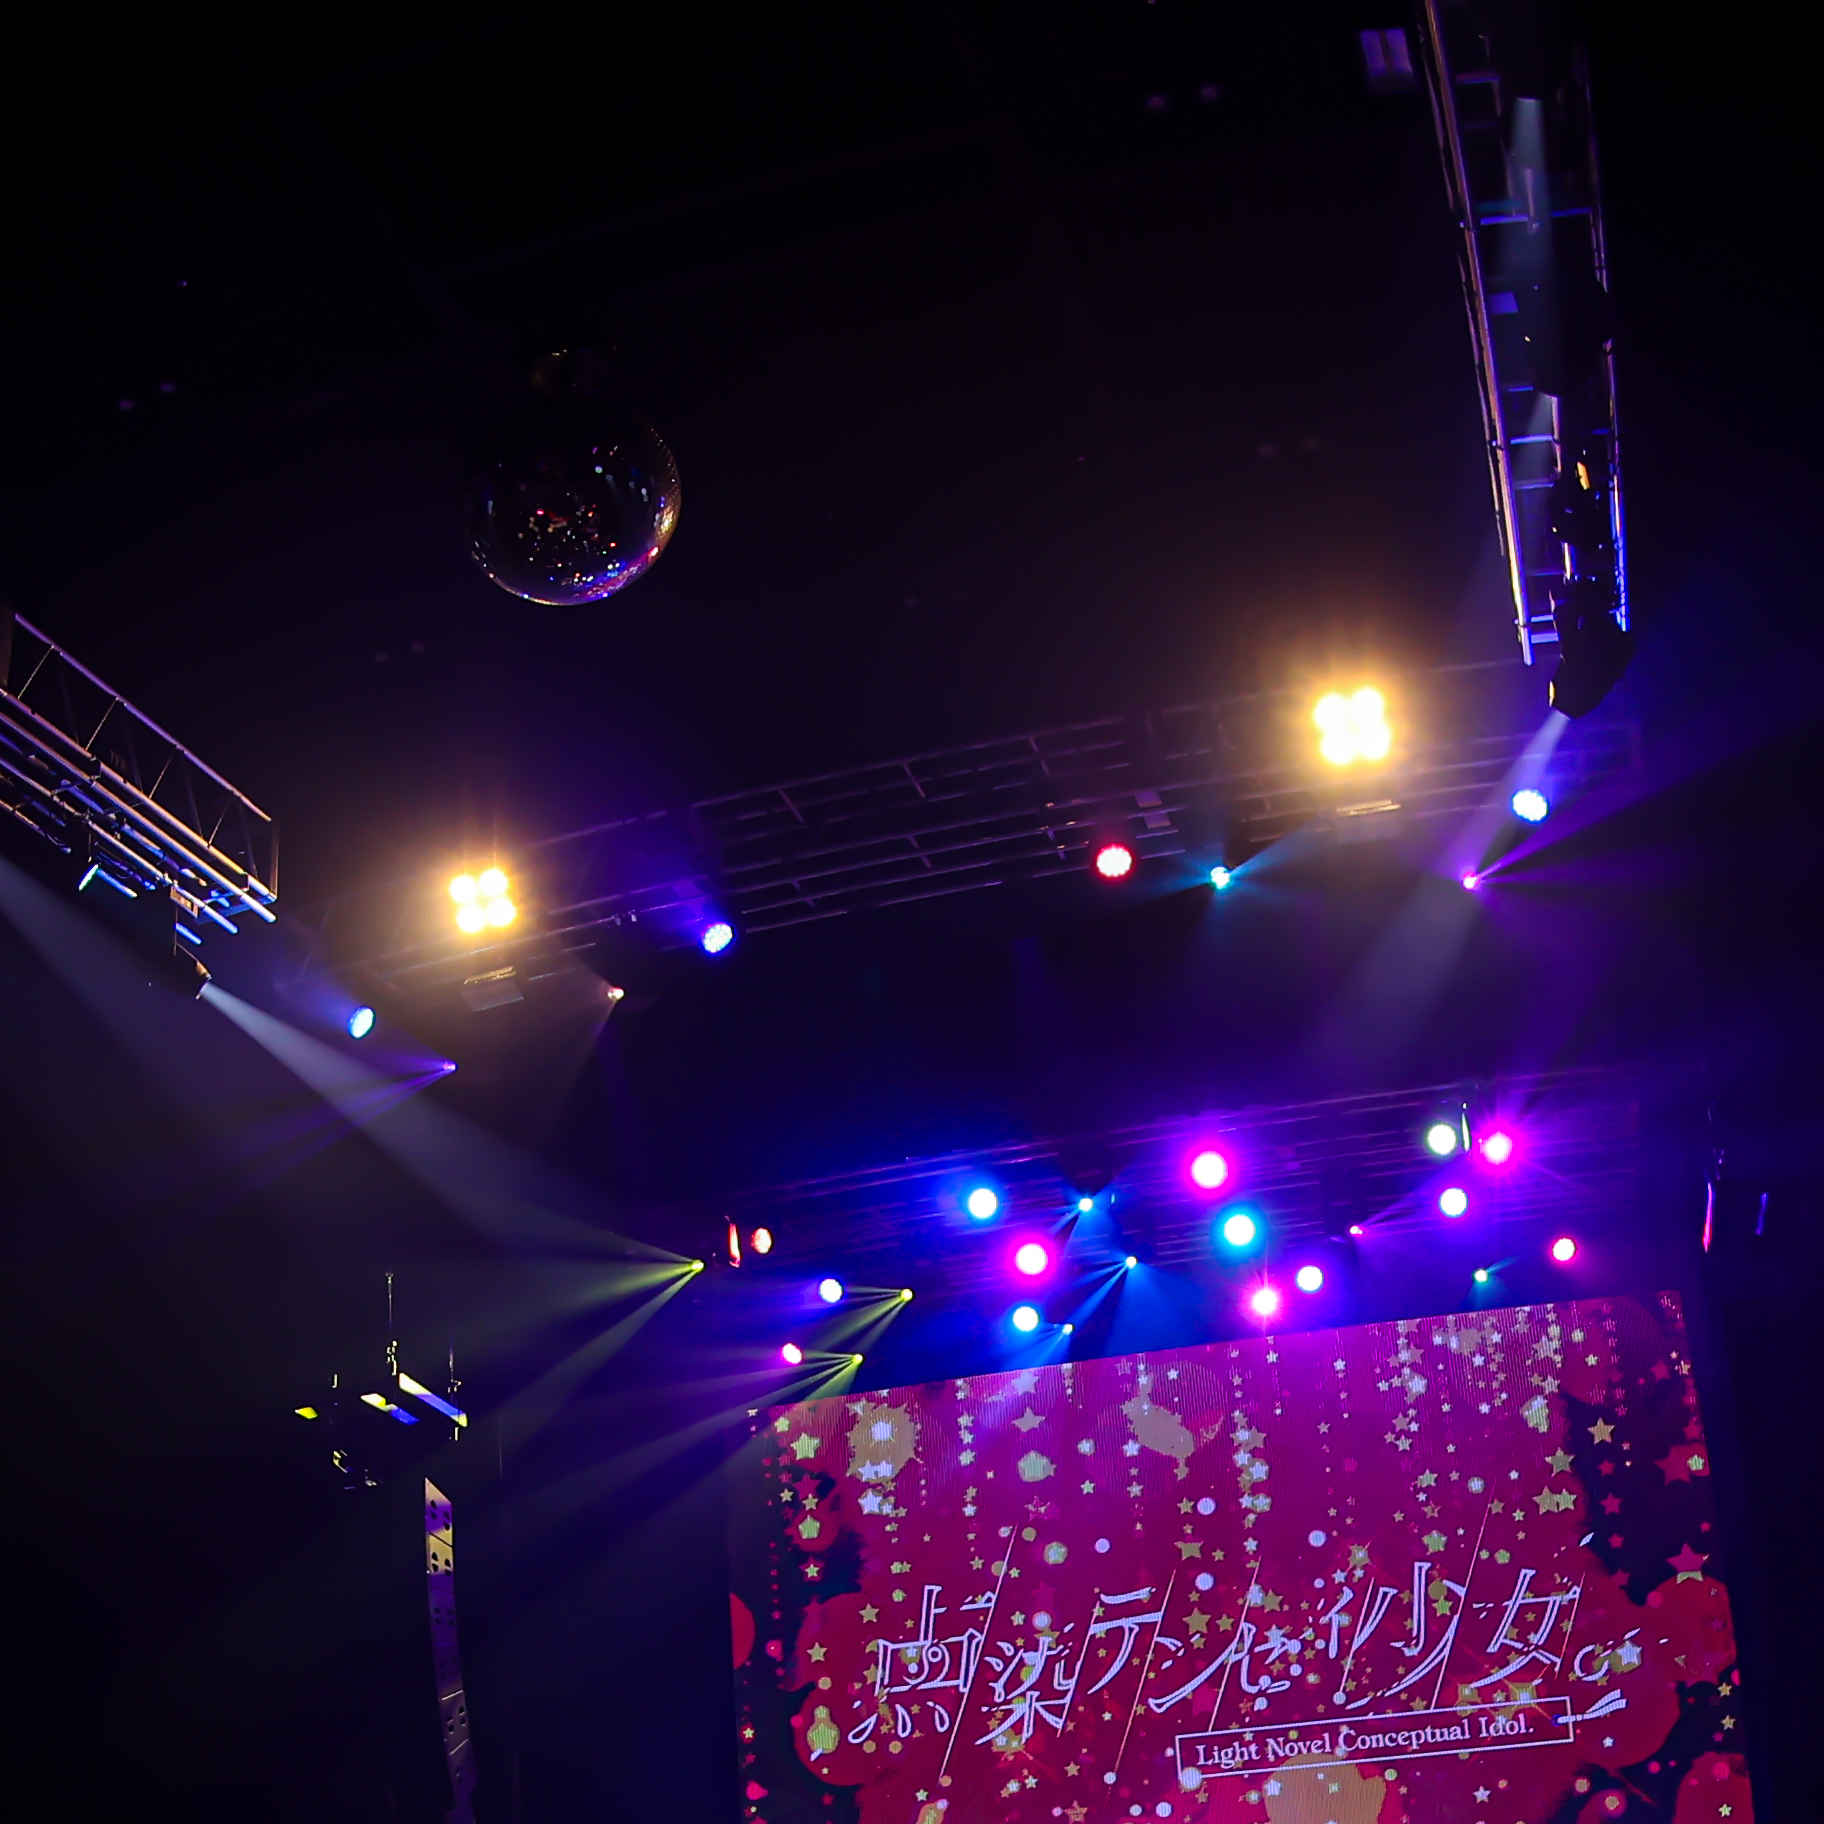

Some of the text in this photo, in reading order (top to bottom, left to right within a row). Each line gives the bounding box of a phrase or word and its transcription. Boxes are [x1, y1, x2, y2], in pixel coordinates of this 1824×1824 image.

[1195, 1713, 1535, 1769] Light Novel Conceptual Idol.
